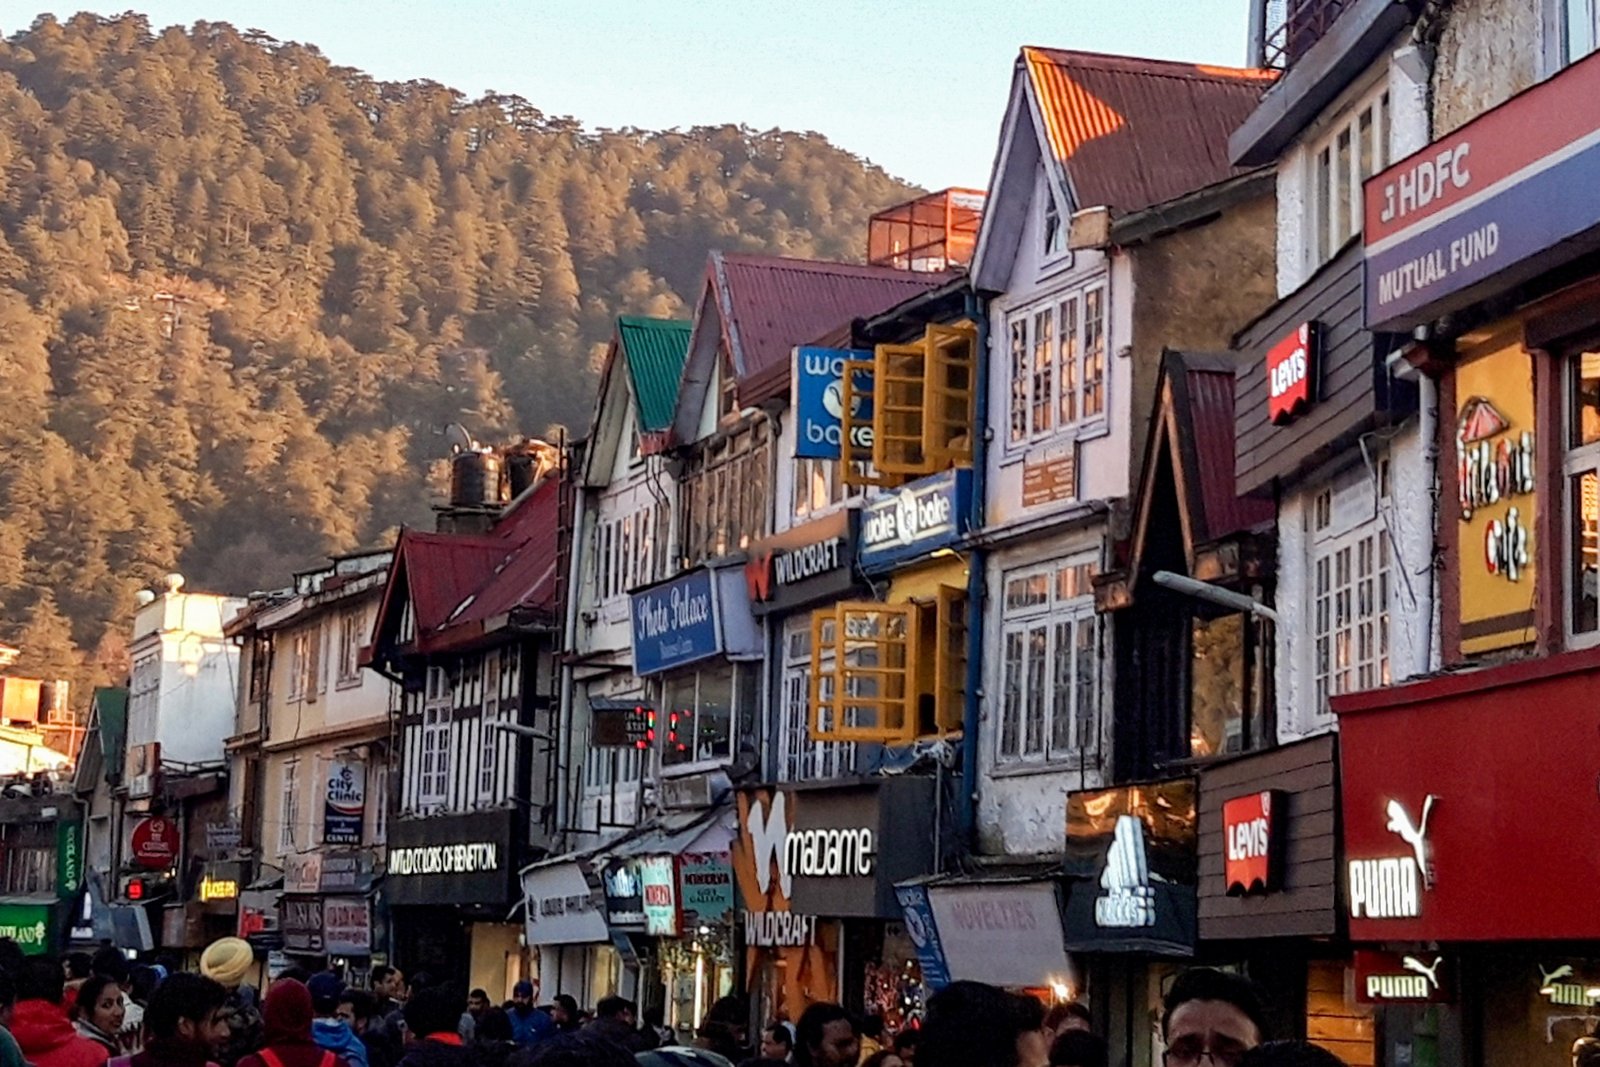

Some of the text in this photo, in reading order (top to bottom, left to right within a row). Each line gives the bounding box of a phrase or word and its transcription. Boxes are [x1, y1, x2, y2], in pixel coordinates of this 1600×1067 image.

[1399, 142, 1471, 217] HDFC
[1379, 221, 1499, 305] MUTUAL FUND
[918, 492, 950, 527] bake
[774, 537, 839, 586] WILDCRAFT
[638, 583, 709, 641] Photo Palace
[327, 779, 353, 792] City
[327, 790, 363, 802] Clinic
[1349, 857, 1419, 918] PUMA
[744, 910, 818, 946] WILDCRAFT
[1367, 975, 1428, 998] PUMA
